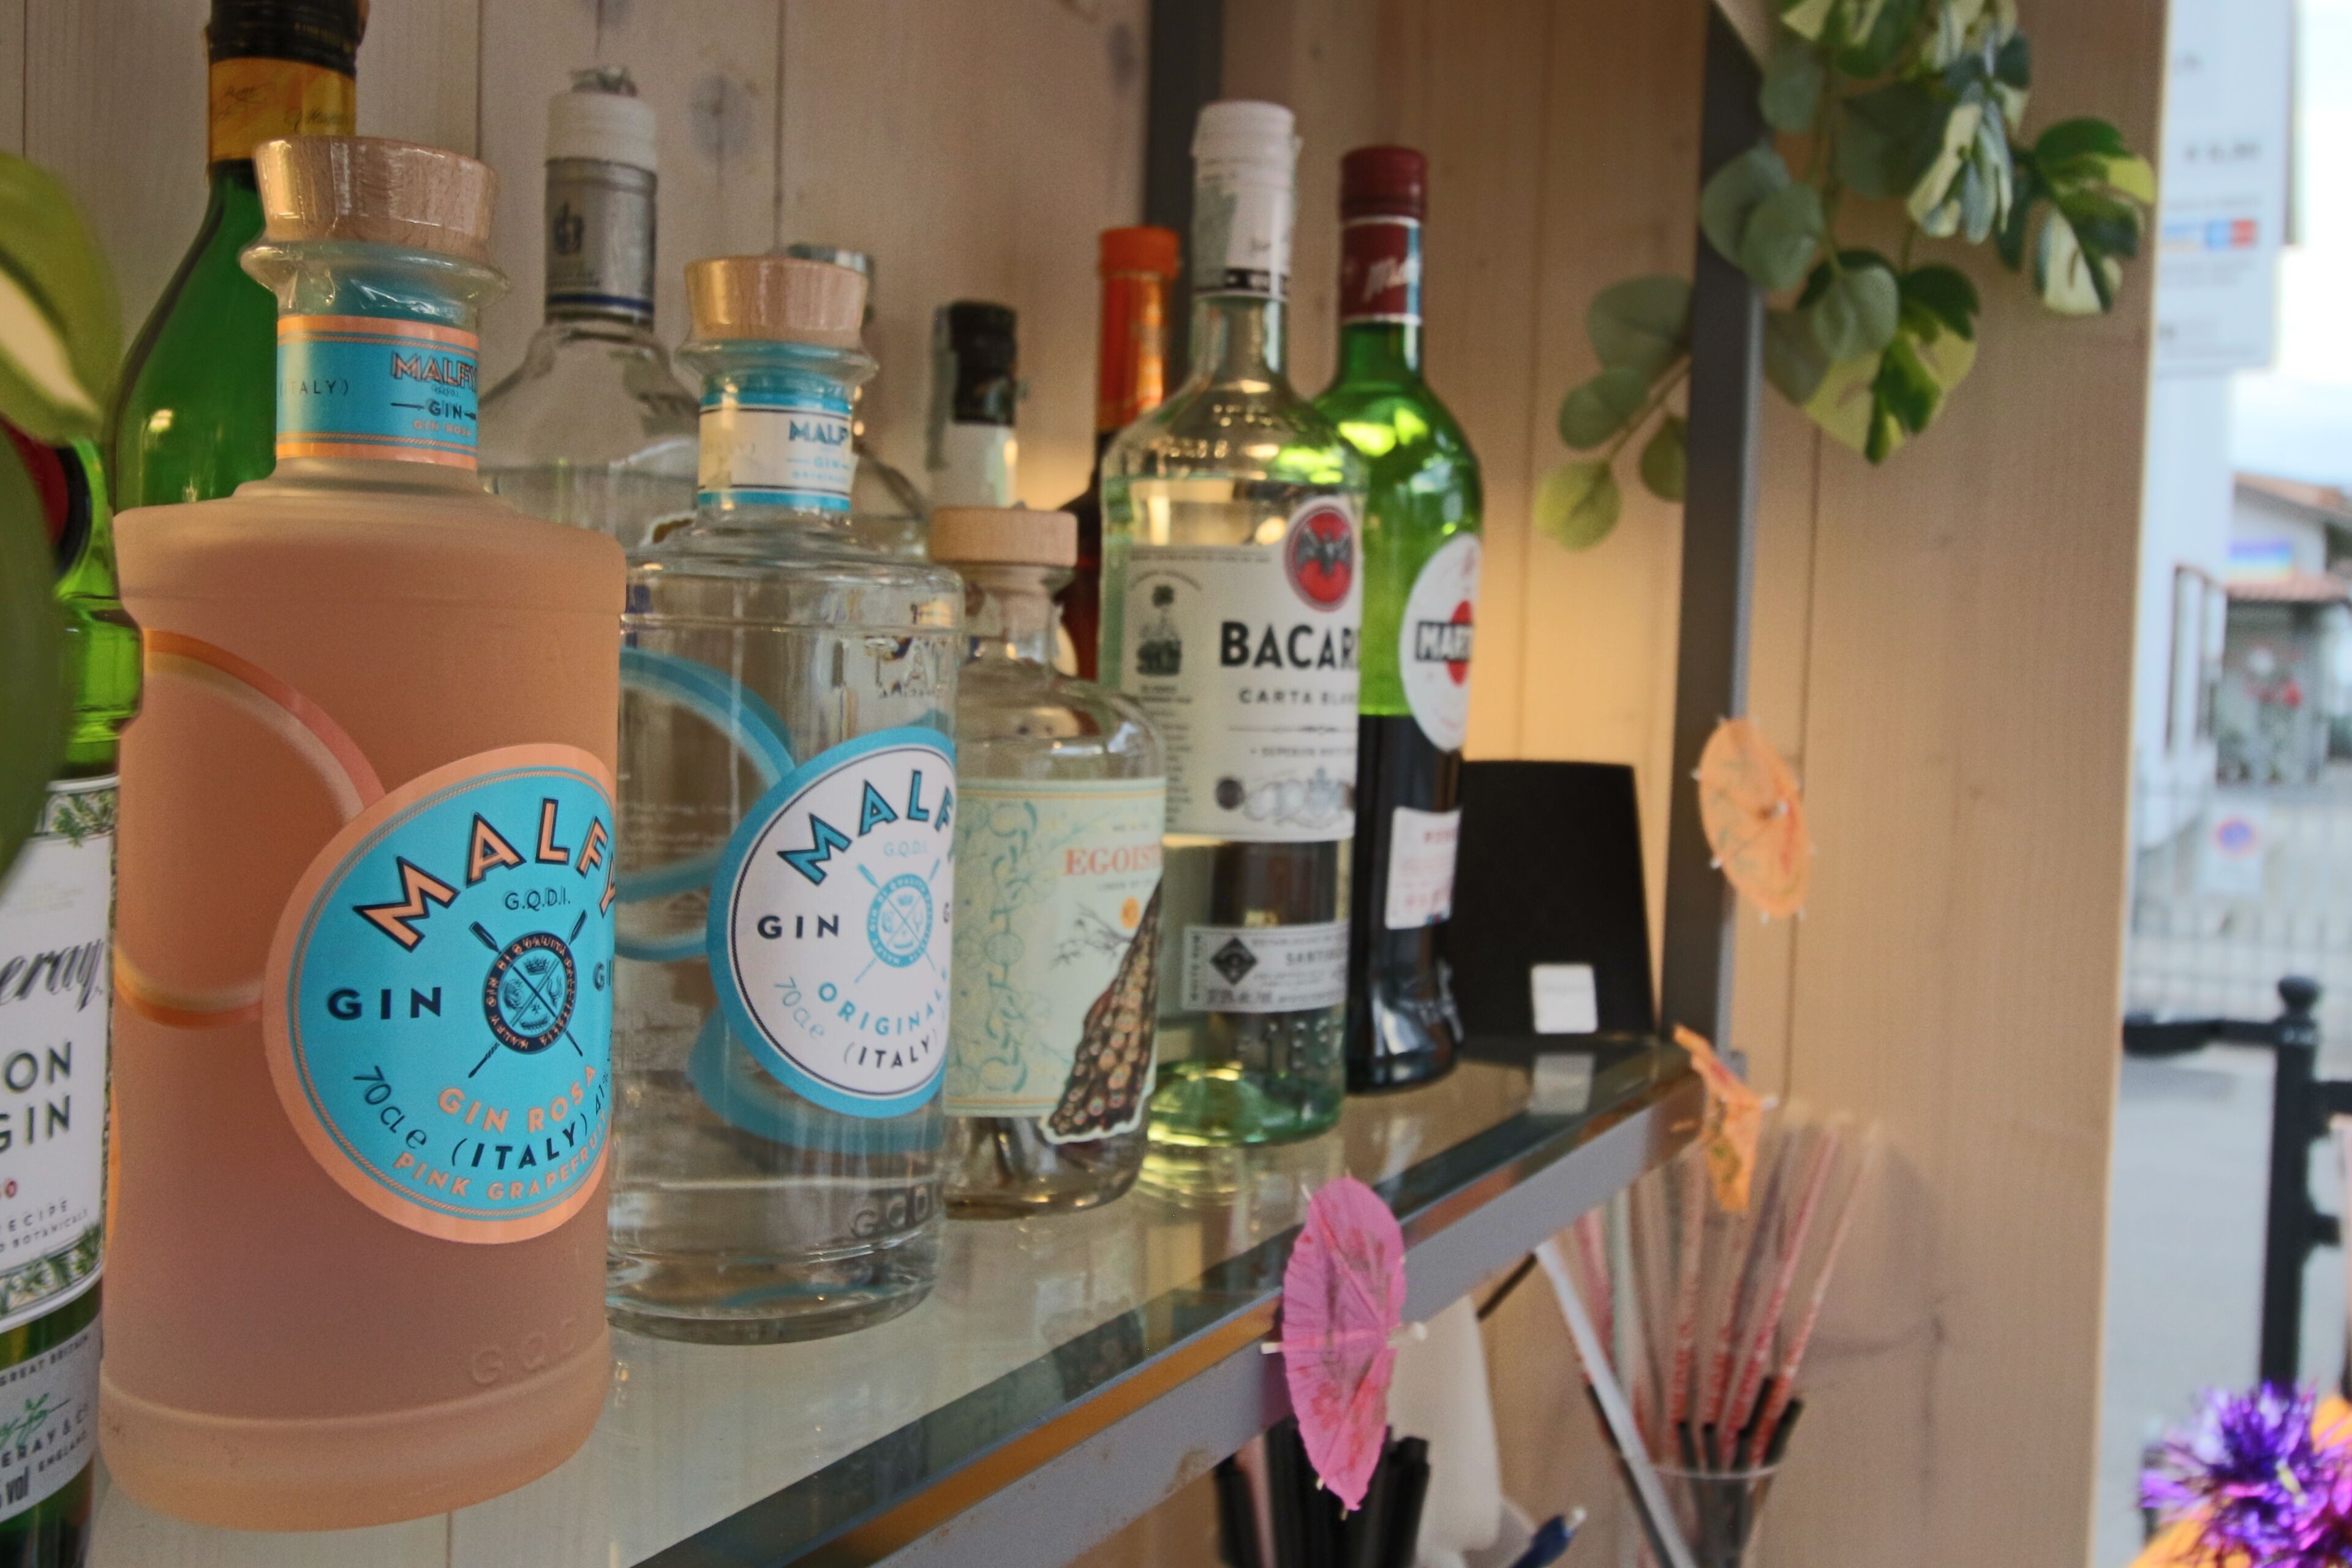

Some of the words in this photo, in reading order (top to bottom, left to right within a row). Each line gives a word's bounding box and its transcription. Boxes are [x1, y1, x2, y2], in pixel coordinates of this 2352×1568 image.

[391, 350, 477, 393] MALFY
[426, 398, 462, 420] GIN
[1237, 687, 1313, 705] CARTA
[353, 797, 616, 953] MALFY
[757, 914, 839, 940] GIN
[326, 987, 442, 1021] GIN
[485, 976, 500, 1008] GIN
[3, 1039, 72, 1094] ON
[843, 1028, 938, 1069] (ITALY)
[438, 1087, 510, 1134] GIN
[527, 1064, 597, 1134] ROSA
[393, 1150, 472, 1197] PINK
[487, 1109, 607, 1201] GRAPEFRUIT
[451, 1112, 589, 1170] (ITALY)
